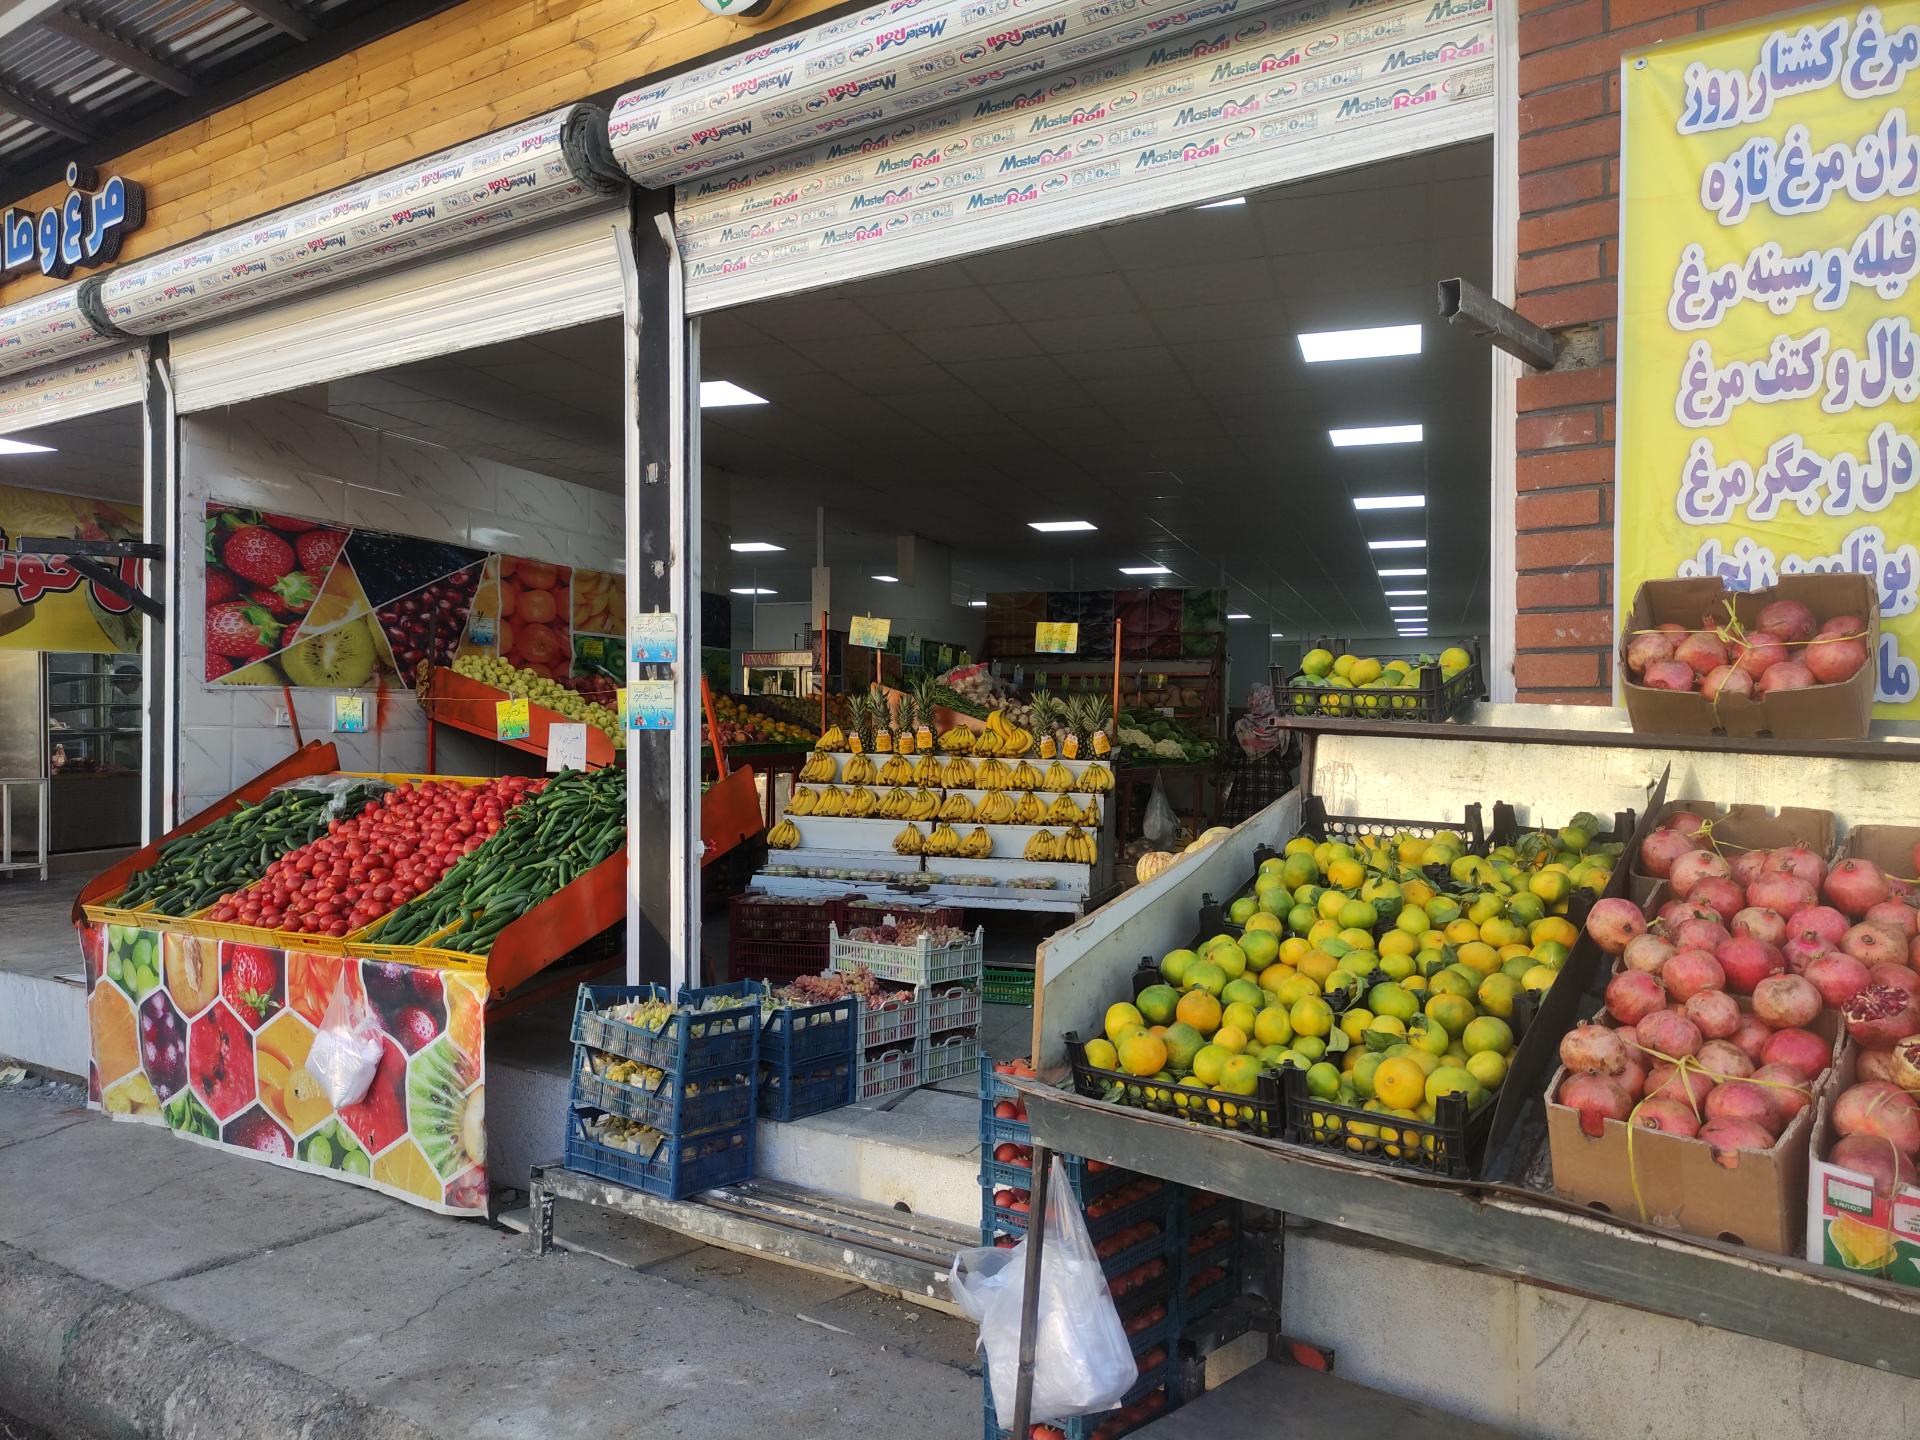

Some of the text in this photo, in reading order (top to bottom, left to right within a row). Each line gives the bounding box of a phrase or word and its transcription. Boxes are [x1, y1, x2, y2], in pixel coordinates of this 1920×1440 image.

[1425, 0, 1493, 23] Master
[876, 18, 948, 51] MasterRoll
[986, 19, 1067, 52] MasterRoll
[745, 37, 807, 65] MasterRoll
[1145, 34, 1231, 68] MasterRoll
[1381, 34, 1484, 73] MasterRoll
[968, 59, 1046, 86] MasterRoll
[1210, 48, 1300, 83] MasterRoll
[1684, 13, 1919, 128] مرغ کشتار روز
[732, 71, 793, 99] MasterRoll
[828, 74, 897, 102] MasterRoll
[974, 88, 1046, 118] MasterRoll
[1173, 95, 1260, 127] MasterRoll
[1336, 83, 1437, 119] MasterRoll
[816, 109, 883, 132] MasterRoll
[1029, 103, 1105, 133] MasterRoll
[692, 120, 752, 146] MasterRoll
[826, 135, 889, 160] MasterRoll
[999, 144, 1073, 173] MasterRoll
[1135, 138, 1220, 168] MasterRoll
[875, 149, 940, 175] MasterRoll
[1708, 116, 1918, 218] ران مرغ تازه
[421, 166, 465, 187] MasterRoll
[488, 173, 537, 194] MasterRoll
[697, 175, 752, 197] MasterRoll
[740, 190, 798, 212] MasterRoll
[850, 186, 913, 211] MasterRoll
[966, 184, 1038, 210] MasterRoll
[0, 161, 125, 275] مرغ و ما
[392, 205, 436, 226] MasterRoll
[720, 221, 775, 243] MasterRoll
[821, 223, 882, 246] MasterRoll
[693, 256, 746, 277] MasterRoll
[1675, 215, 1917, 324] فیله و سینه مرغ
[1683, 322, 1915, 421] بال و کتف مرغ
[1684, 430, 1914, 517] دل و جگر مرغ
[1786, 534, 1911, 610] بوقل
[1880, 640, 1910, 696] ما
